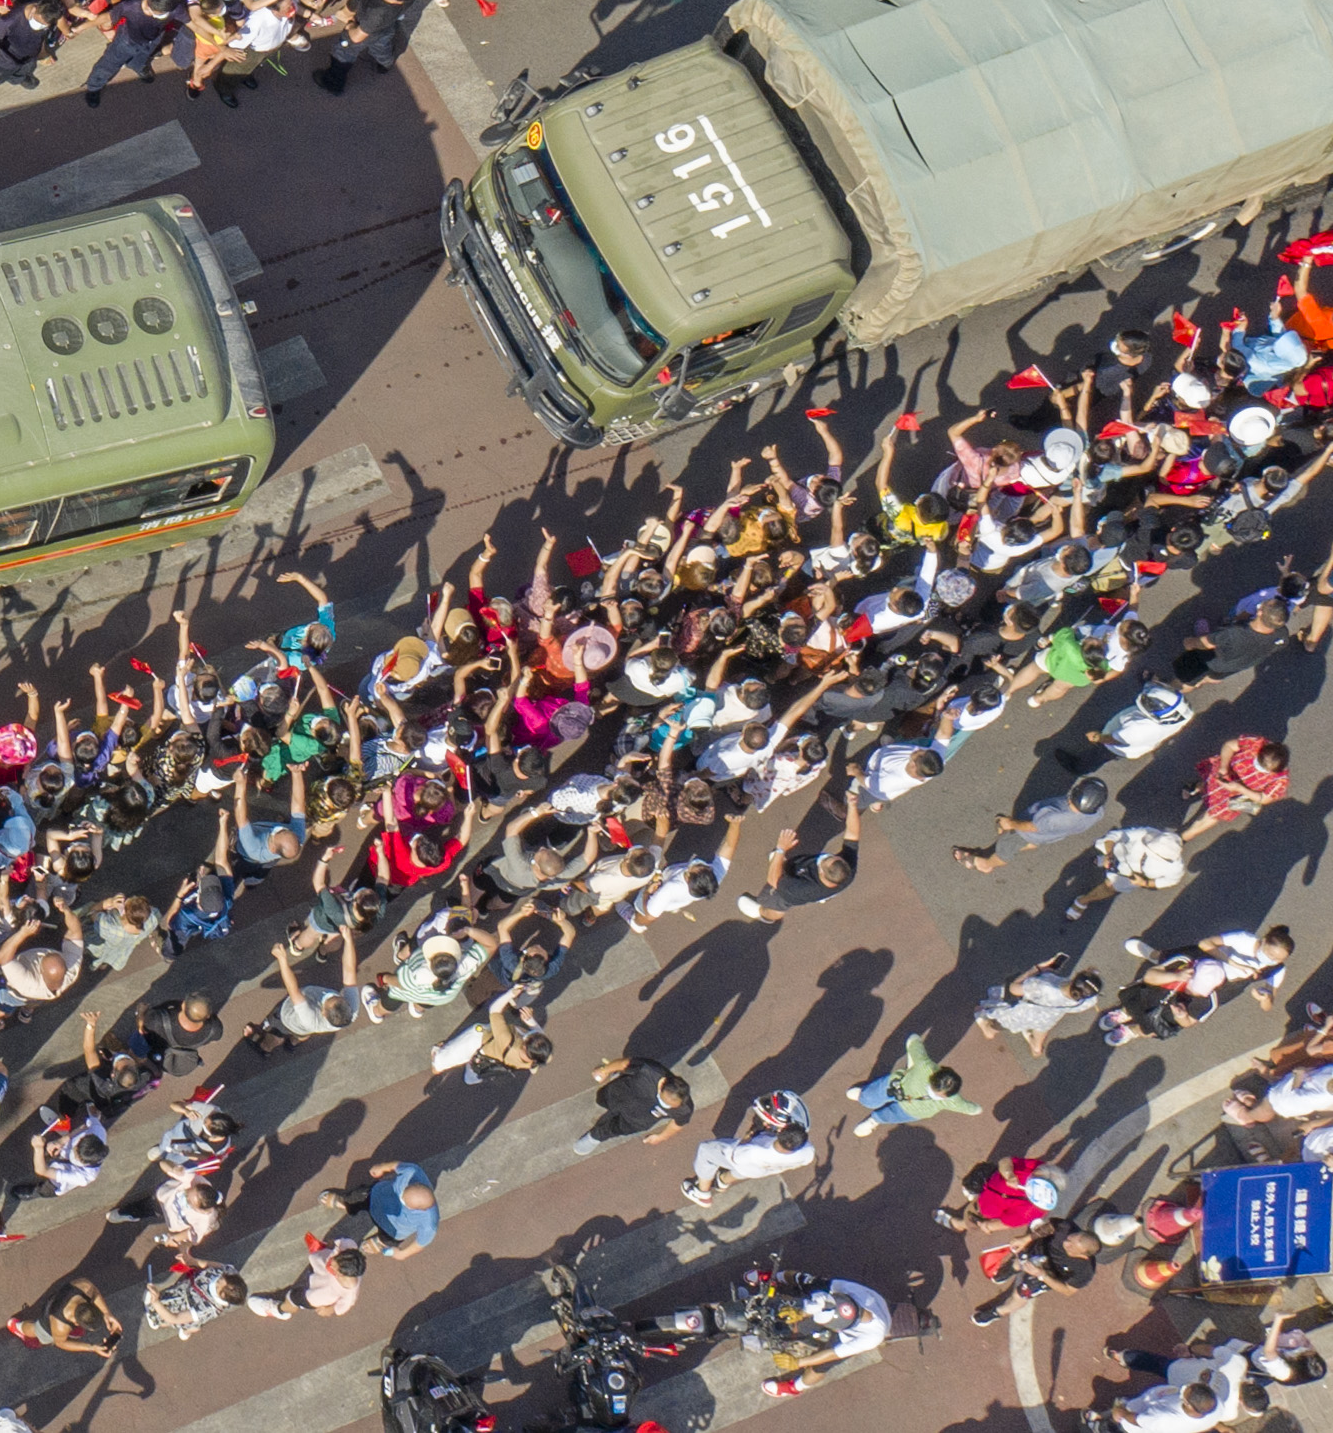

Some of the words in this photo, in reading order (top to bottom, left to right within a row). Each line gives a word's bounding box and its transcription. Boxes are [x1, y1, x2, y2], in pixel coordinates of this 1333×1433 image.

[655, 124, 751, 239] 1516
[501, 258, 544, 330] RESCUE
[1249, 1199, 1261, 1246] 禁止入校
[1264, 1181, 1277, 1263] 校外人员及车辆
[1293, 1188, 1309, 1249] 温馨提示
